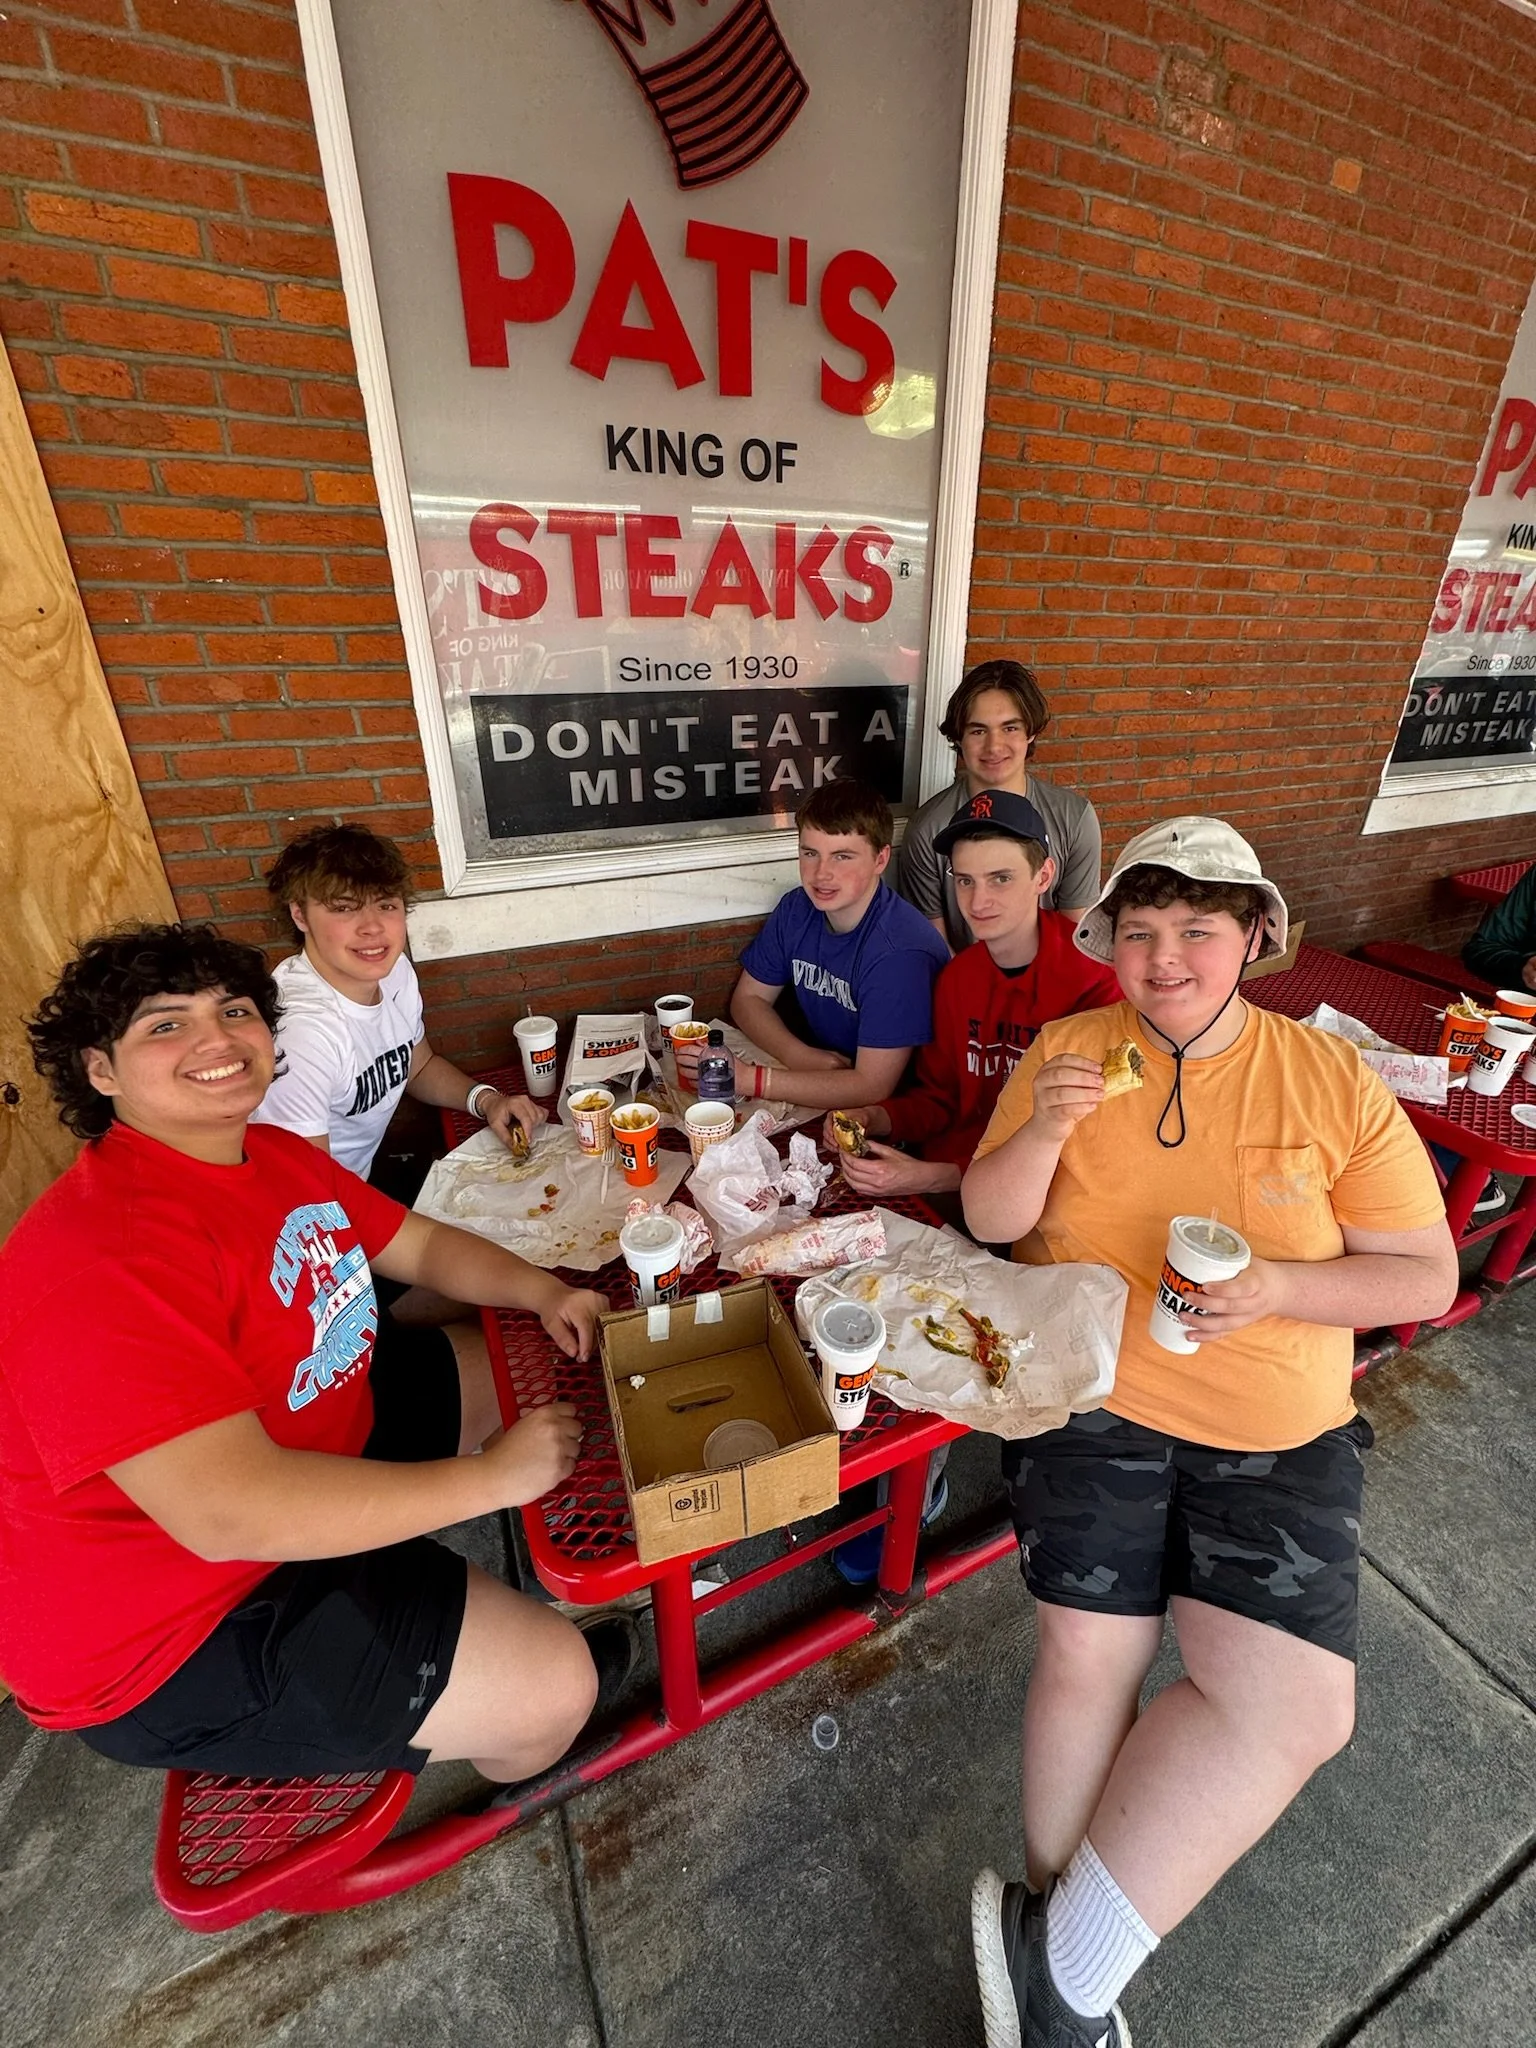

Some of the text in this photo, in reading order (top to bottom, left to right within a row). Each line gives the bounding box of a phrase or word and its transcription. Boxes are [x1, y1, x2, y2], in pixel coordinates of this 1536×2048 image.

[447, 173, 897, 416] PAT'S
[606, 425, 797, 483] KING OF
[469, 502, 895, 624] STEAKS
[619, 656, 798, 682] Since 1930
[1467, 655, 1505, 672] Since
[1404, 692, 1488, 718] DON'T
[489, 709, 896, 762] DON'T EAT A
[1420, 718, 1532, 747] MISTEAK
[570, 755, 842, 807] MISTEAK
[587, 1036, 636, 1049] STEAKS
[345, 1039, 414, 1117] MAVER
